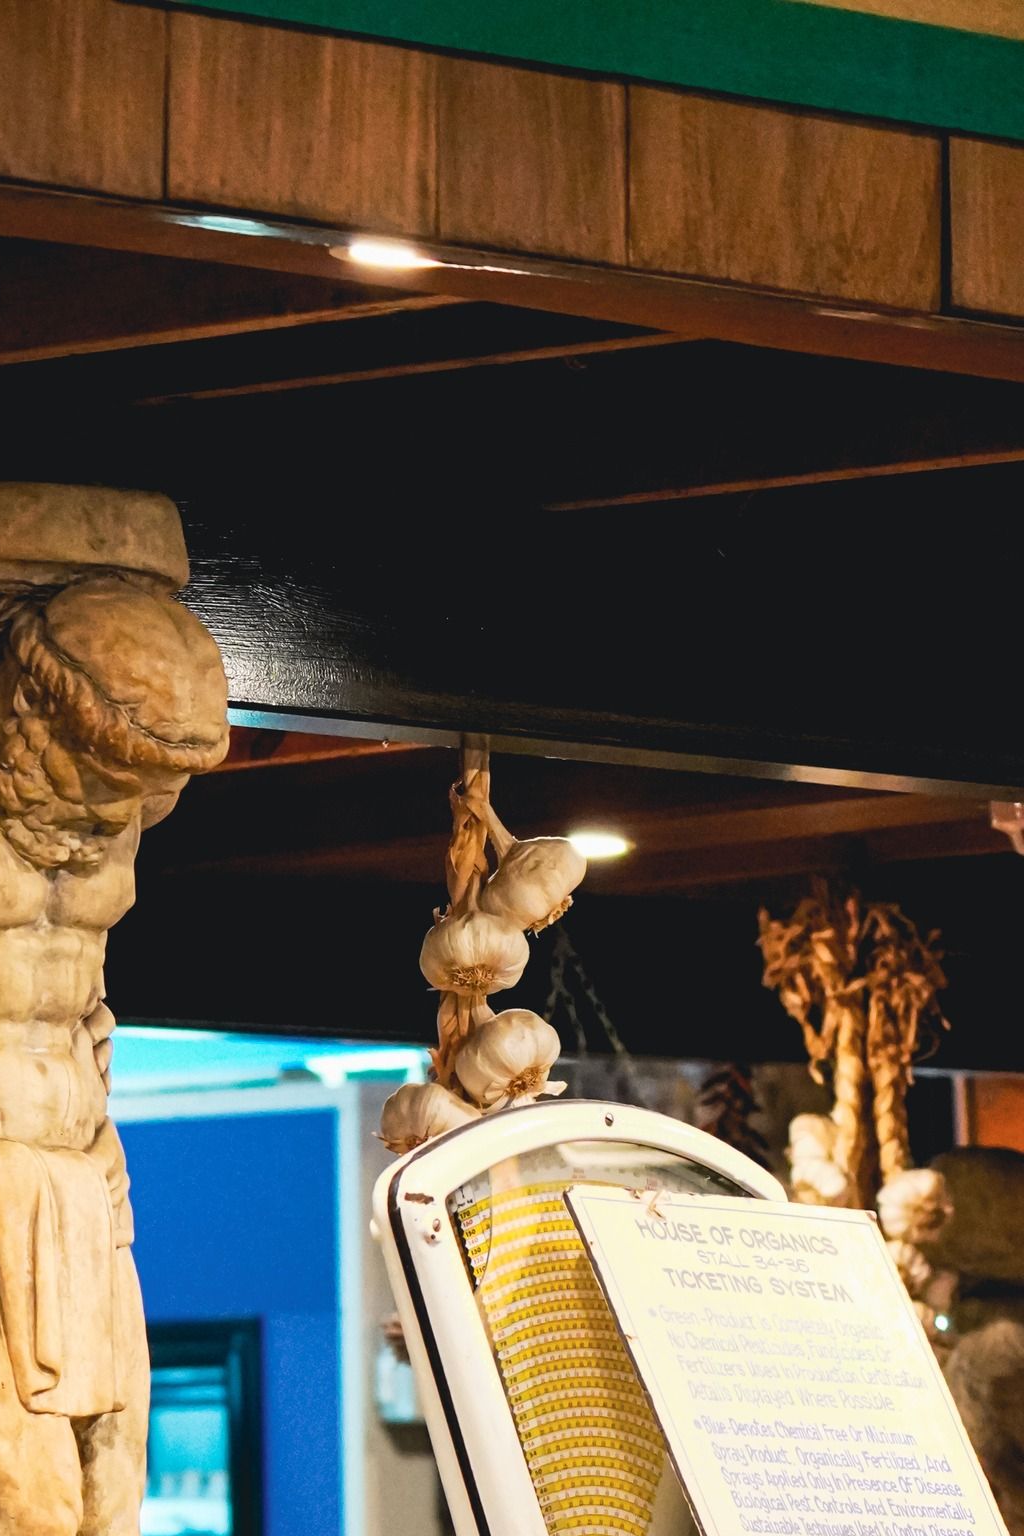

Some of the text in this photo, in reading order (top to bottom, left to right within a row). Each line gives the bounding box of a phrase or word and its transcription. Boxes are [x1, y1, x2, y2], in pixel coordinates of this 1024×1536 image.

[634, 1219, 839, 1256] HOUSE OF ORGANICS
[696, 1250, 810, 1274] STALL 34-36
[661, 1267, 854, 1304] TICKETING SYSTEM
[685, 1331, 740, 1353] Chemical
[744, 1360, 782, 1379] Used
[687, 1379, 734, 1403] Details
[733, 1383, 796, 1410] Displayed
[795, 1388, 839, 1409] Where
[774, 1420, 821, 1441] Chemical
[822, 1423, 849, 1441] Free
[849, 1425, 865, 1441] Or
[865, 1425, 921, 1447] Minimum
[711, 1441, 745, 1466] Spray
[794, 1446, 865, 1473] Organically
[926, 1454, 953, 1473] And
[721, 1466, 764, 1491] Sprays
[765, 1469, 808, 1491] Applied
[806, 1471, 834, 1494] Only
[843, 1474, 899, 1496] Presence
[730, 1491, 977, 1525] Biological Pest Controls And Environmentally
[739, 1513, 801, 1536] Sustainable
